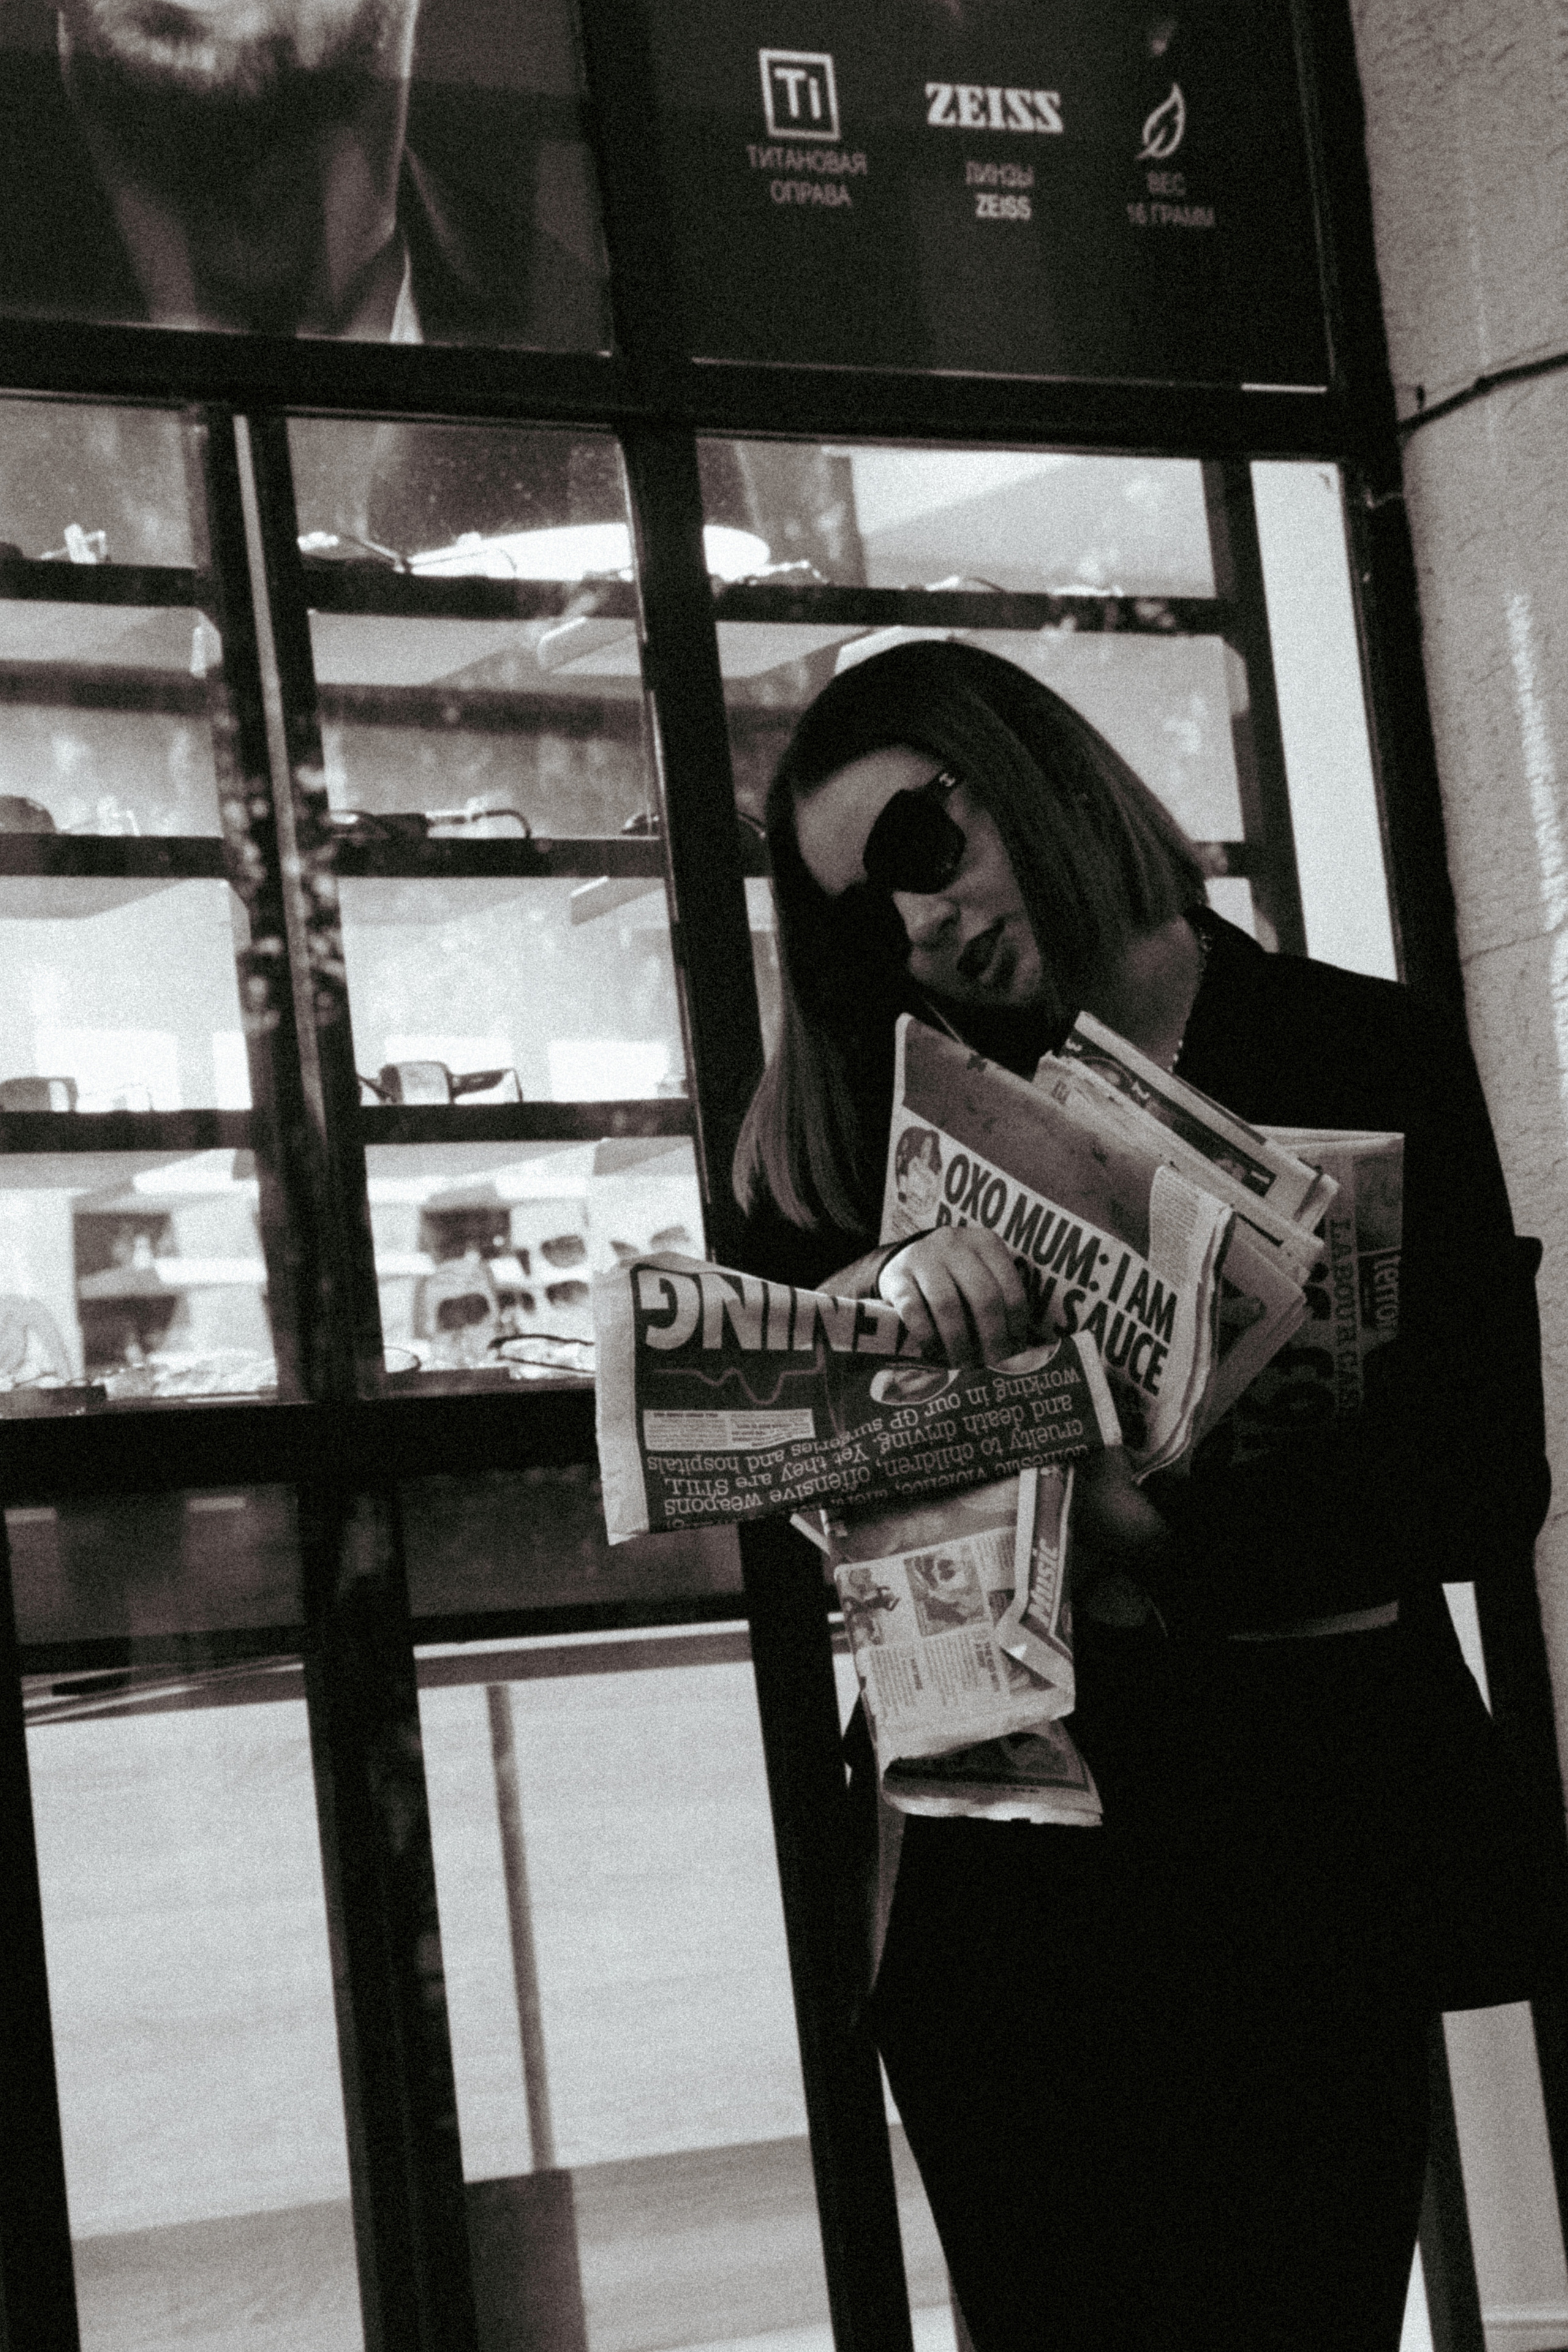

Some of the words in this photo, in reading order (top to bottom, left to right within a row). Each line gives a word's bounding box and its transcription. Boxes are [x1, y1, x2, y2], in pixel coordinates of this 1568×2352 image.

[773, 67, 821, 121] Ti
[925, 81, 1064, 134] ZEISS
[745, 144, 868, 176] ТИТАНОВАЯ
[770, 179, 854, 208] ОПРАВА
[975, 193, 1033, 221] ZEISS
[944, 1153, 1008, 1229] OXO
[1003, 1193, 1110, 1292] MUM:
[1107, 1251, 1131, 1304] I
[1125, 1267, 1178, 1344] AM
[1052, 1288, 1168, 1397] SAUCE
[966, 1385, 990, 1407] in
[992, 1366, 1082, 1403] working
[890, 1408, 918, 1428] GP
[924, 1392, 962, 1418] our
[962, 1404, 1025, 1432] death
[1030, 1393, 1072, 1423] and
[872, 1419, 957, 1455] driving.
[981, 1436, 1003, 1455] to
[1009, 1419, 1084, 1450] cruelty
[646, 1453, 740, 1475] hospitals
[745, 1448, 786, 1472] and
[780, 1455, 827, 1482] they
[834, 1443, 870, 1466] Yet
[875, 1441, 975, 1479] children,
[664, 1478, 729, 1497] STILL
[736, 1472, 772, 1488] are
[769, 1466, 870, 1503] offensive
[664, 1488, 764, 1517] weapons
